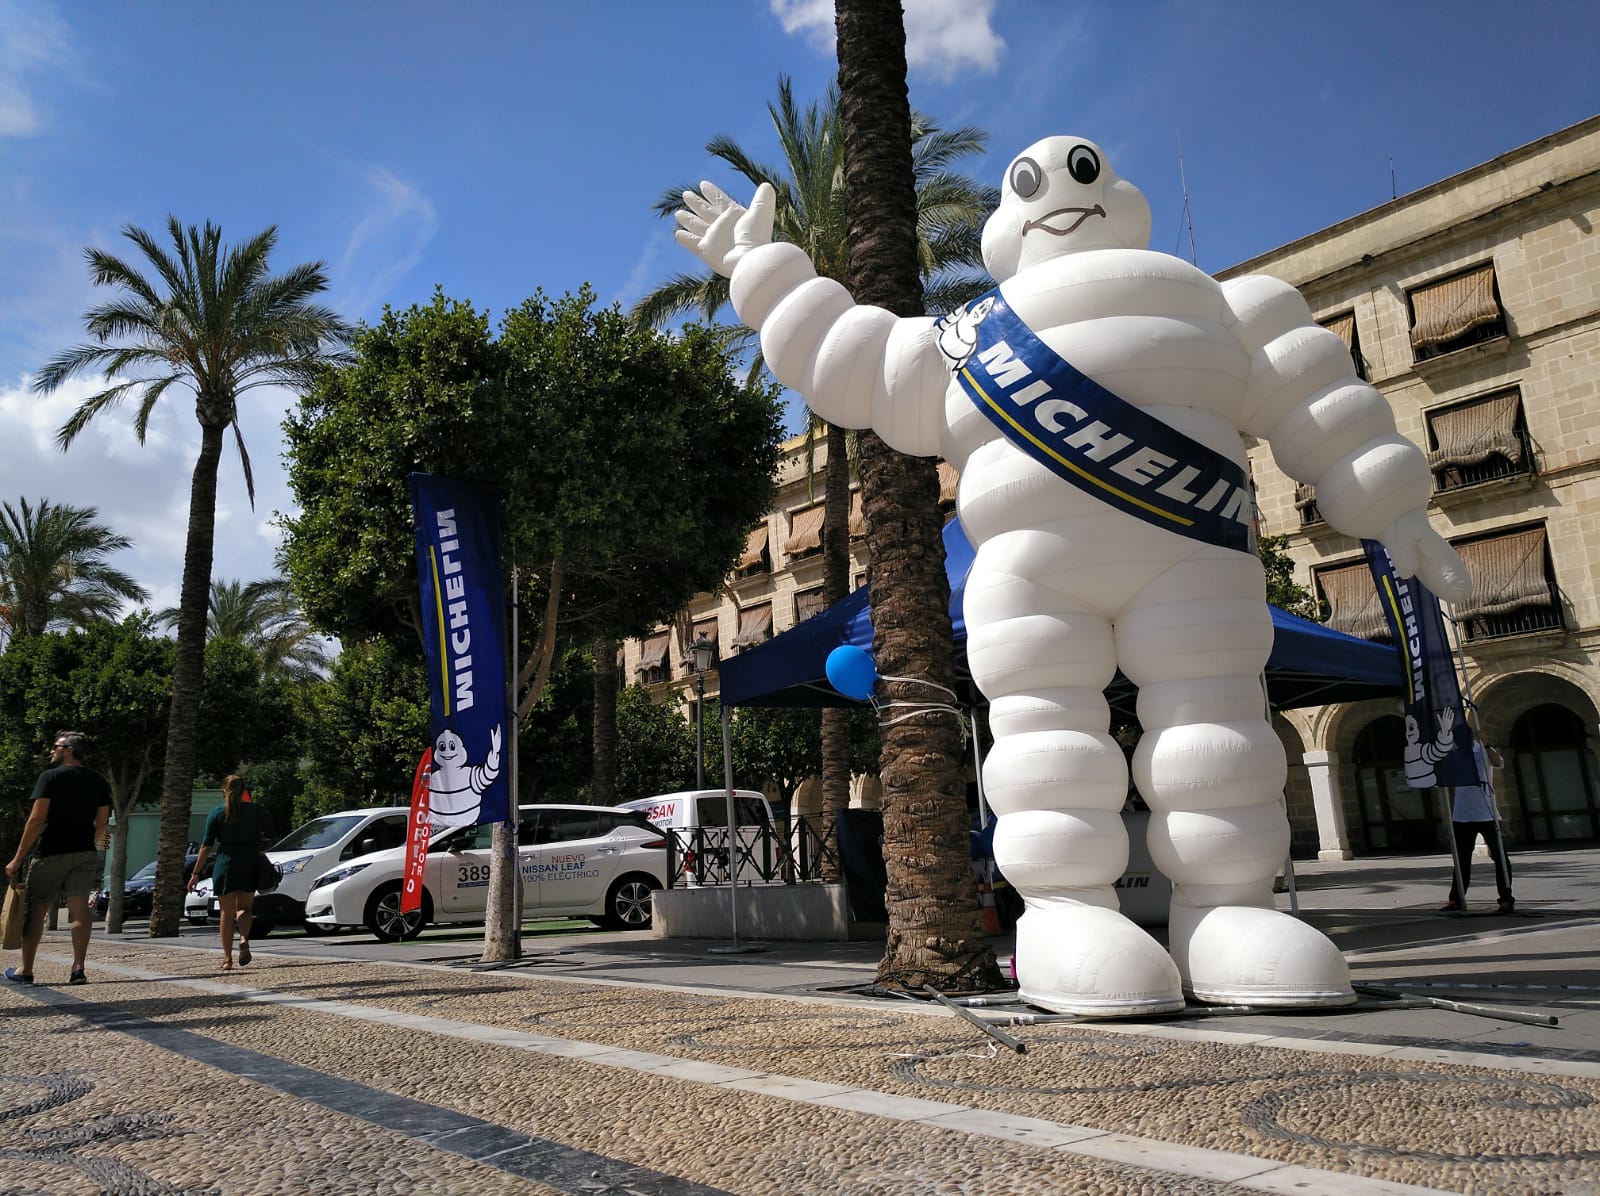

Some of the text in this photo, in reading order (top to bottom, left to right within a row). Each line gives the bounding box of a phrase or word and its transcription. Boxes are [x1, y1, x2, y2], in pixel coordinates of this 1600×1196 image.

[976, 339, 1250, 526] MICHELIN
[551, 853, 586, 863] NUEVO
[458, 865, 491, 882] 389
[522, 861, 586, 874] NISSAN LEAF
